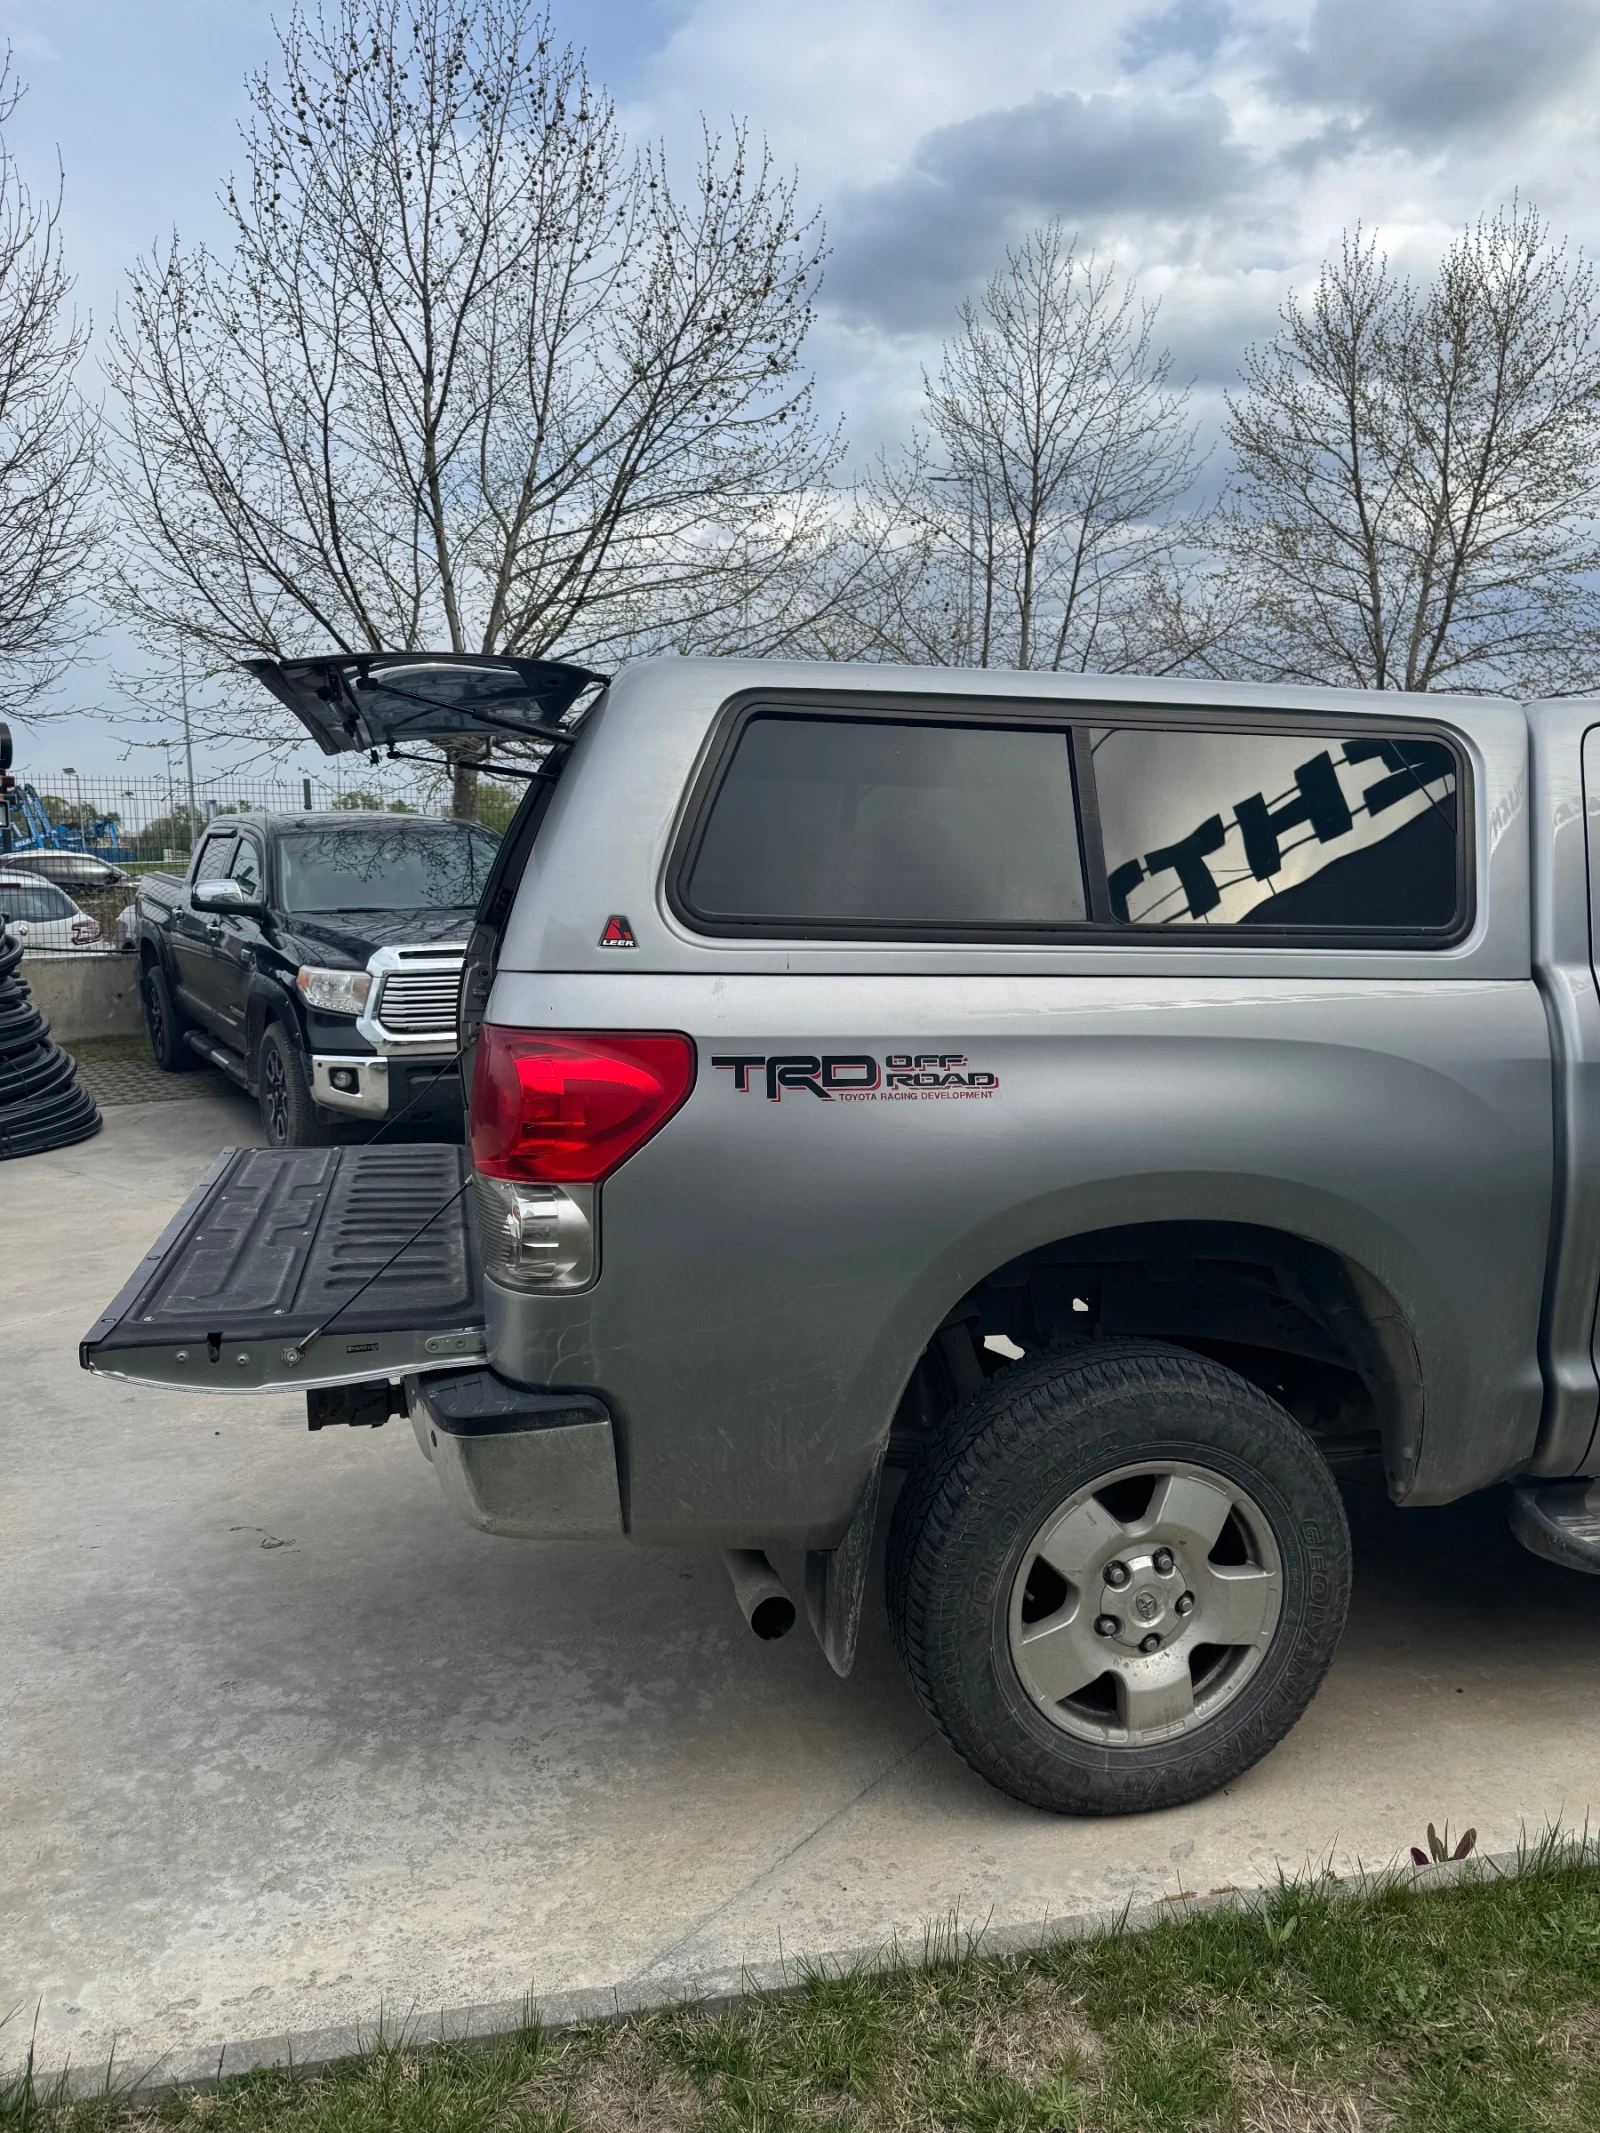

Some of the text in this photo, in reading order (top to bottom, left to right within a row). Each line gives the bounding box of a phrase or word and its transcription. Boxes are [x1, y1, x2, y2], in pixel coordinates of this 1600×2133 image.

[885, 1054, 968, 1072] OFF
[711, 1055, 882, 1102] TRD
[885, 1073, 999, 1091] ROAD
[839, 1091, 993, 1101] TOYOTA RACING DEVELOPMENT
[970, 1433, 1122, 1629] YOKOHAMA
